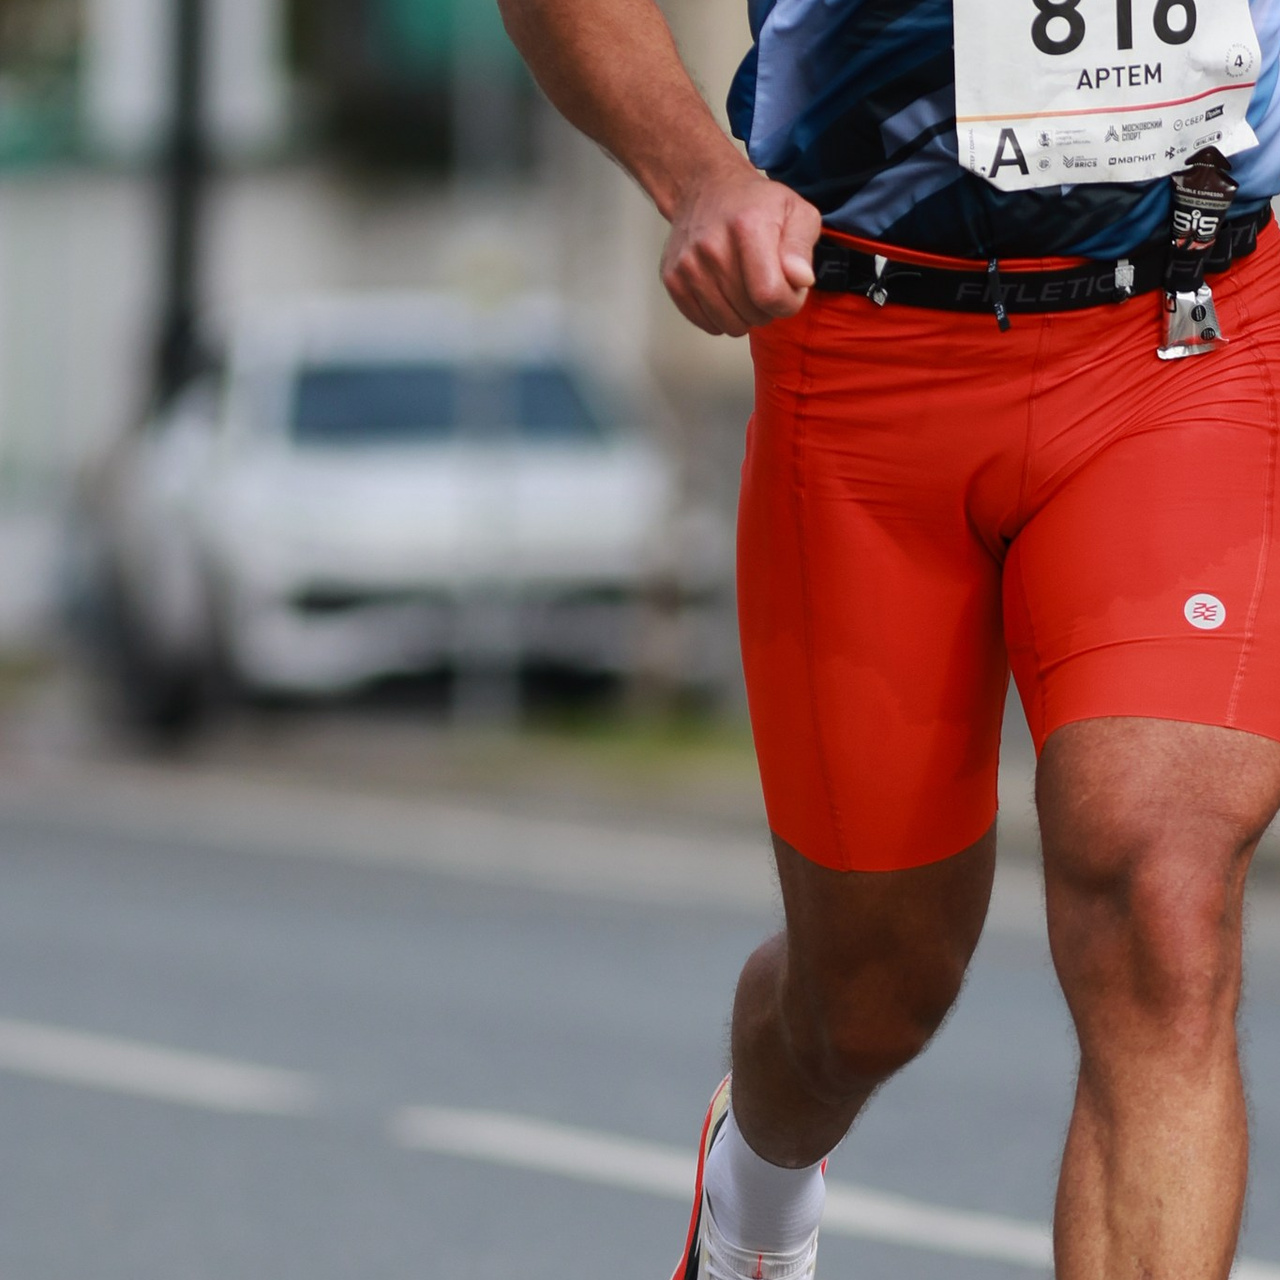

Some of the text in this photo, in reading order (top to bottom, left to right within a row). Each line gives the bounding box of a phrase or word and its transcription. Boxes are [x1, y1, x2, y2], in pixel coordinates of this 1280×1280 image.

[1234, 54, 1243, 67] 4
[1076, 62, 1162, 90] АРТЕМ
[1121, 118, 1163, 132] МОСКОВСКИЙ
[1184, 114, 1204, 127] СБЕР
[1121, 132, 1141, 141] СПОРТ
[988, 128, 1029, 178] A
[1176, 185, 1224, 198] DOUBLE ESPRESSO
